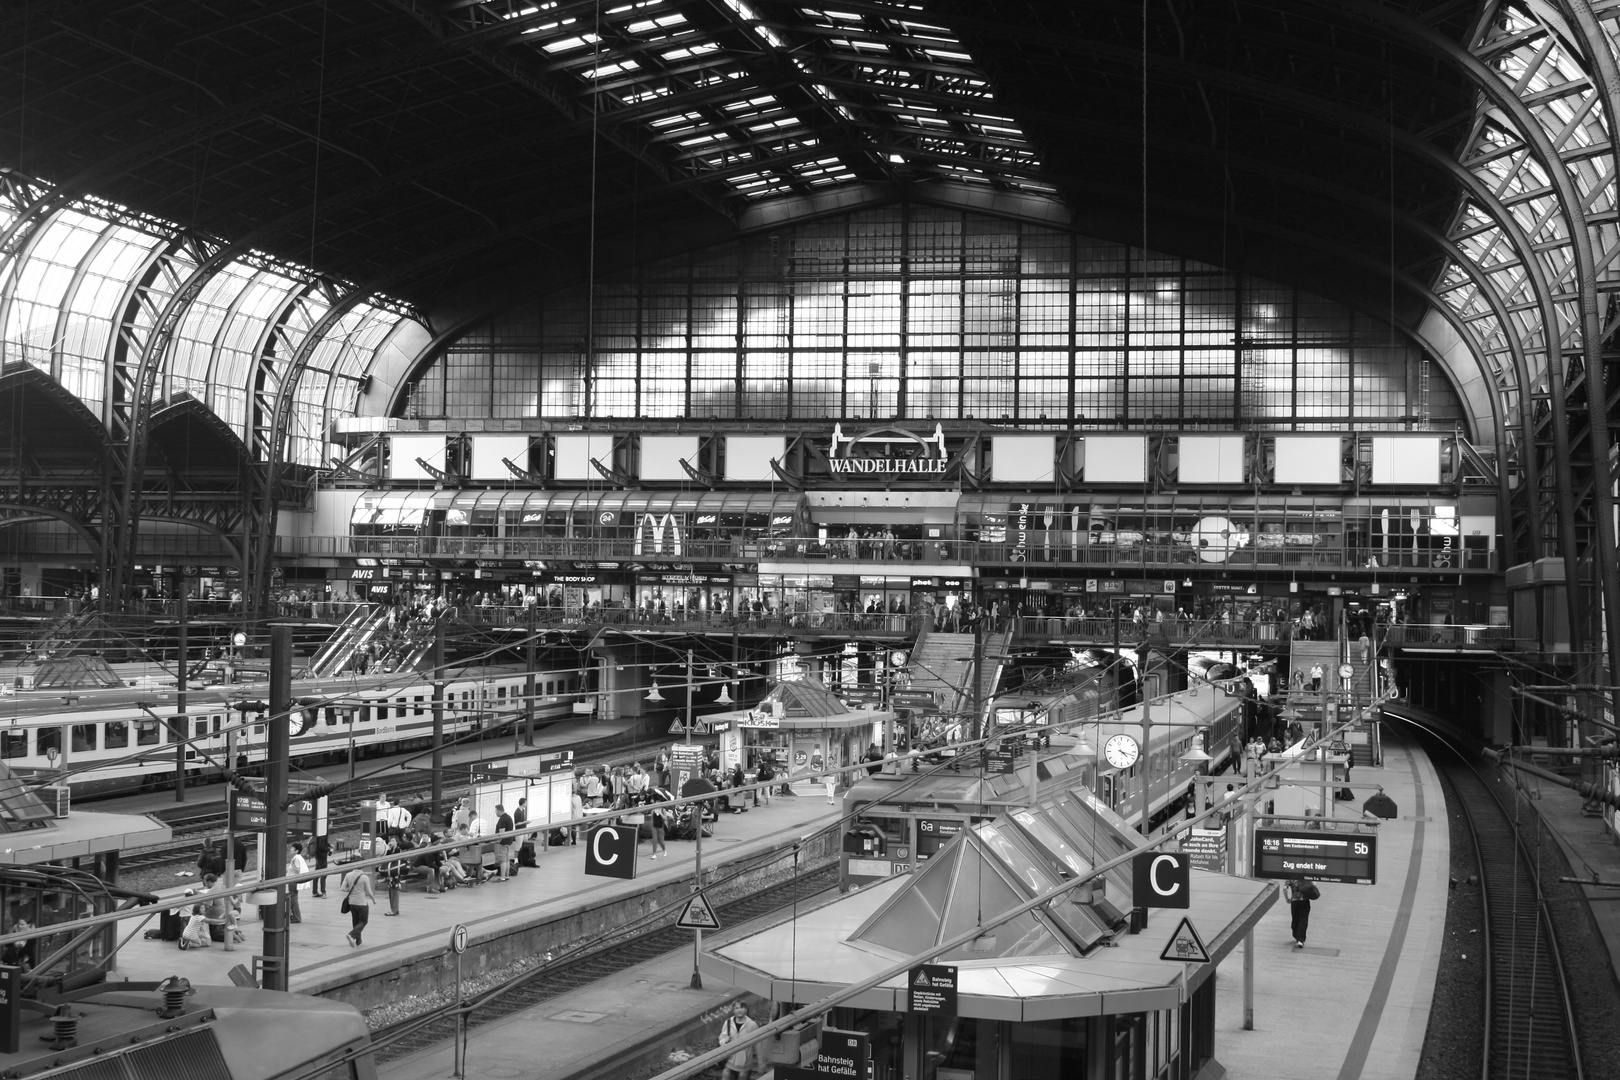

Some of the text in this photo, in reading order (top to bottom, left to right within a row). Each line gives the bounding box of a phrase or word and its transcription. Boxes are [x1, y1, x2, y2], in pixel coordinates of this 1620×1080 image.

[829, 459, 947, 474] WANDELHALLE
[635, 513, 680, 555] M
[351, 570, 374, 579] AVIS
[709, 669, 716, 677] E
[875, 673, 882, 684] E
[190, 718, 194, 726] 2
[376, 726, 395, 735] BordBistro
[302, 800, 312, 811] 7b
[920, 820, 933, 832] 6a
[593, 827, 619, 866] C
[1354, 842, 1369, 855] 5b
[1283, 861, 1294, 869] Zug
[1315, 862, 1327, 870] hier
[1149, 855, 1180, 896] C
[818, 1054, 854, 1067] Bahnsteig
[817, 1064, 857, 1076] hat Gefälle
